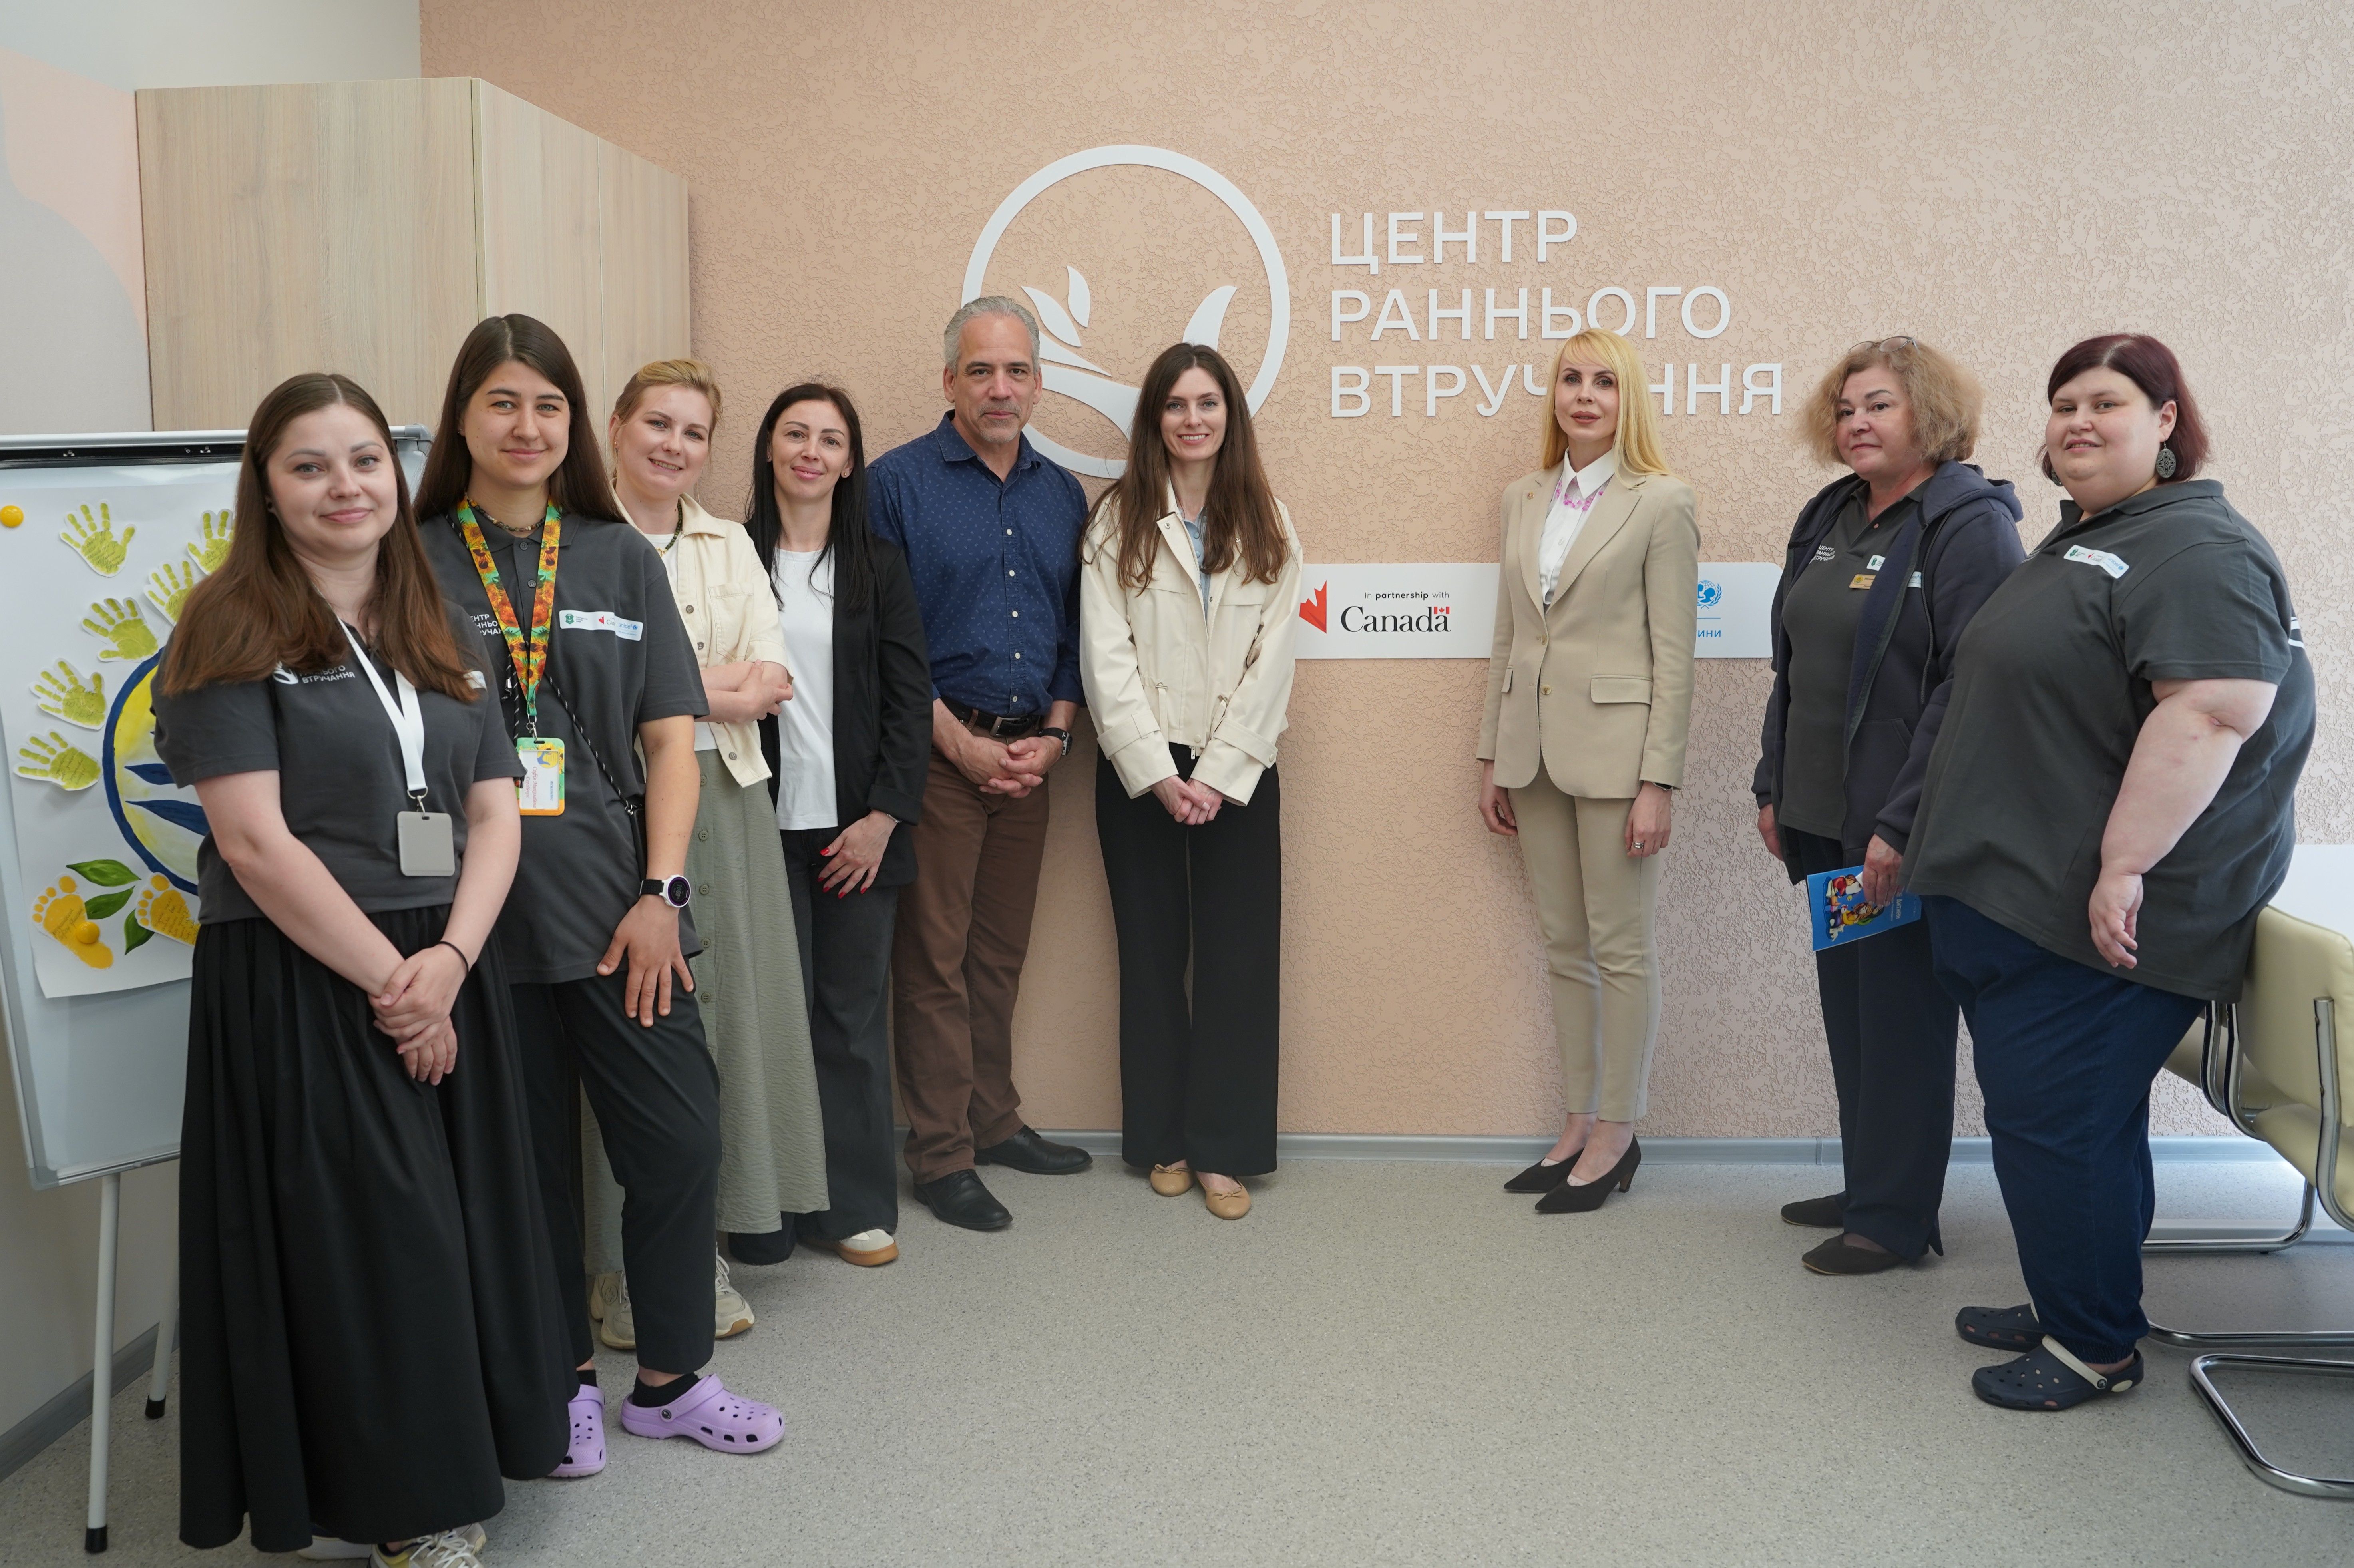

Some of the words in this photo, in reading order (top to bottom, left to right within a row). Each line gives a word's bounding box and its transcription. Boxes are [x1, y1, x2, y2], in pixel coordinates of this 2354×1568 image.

[1331, 210, 1578, 275] ЦЕНТР
[1331, 286, 1730, 341] РАННЬОГО
[1331, 363, 1782, 417] ВТРУЧННЯ
[1375, 591, 1429, 600] partnership
[470, 613, 490, 622] ЕНТР
[1341, 606, 1451, 632] Canada
[301, 671, 356, 684] ВТРУЧАННЯ
